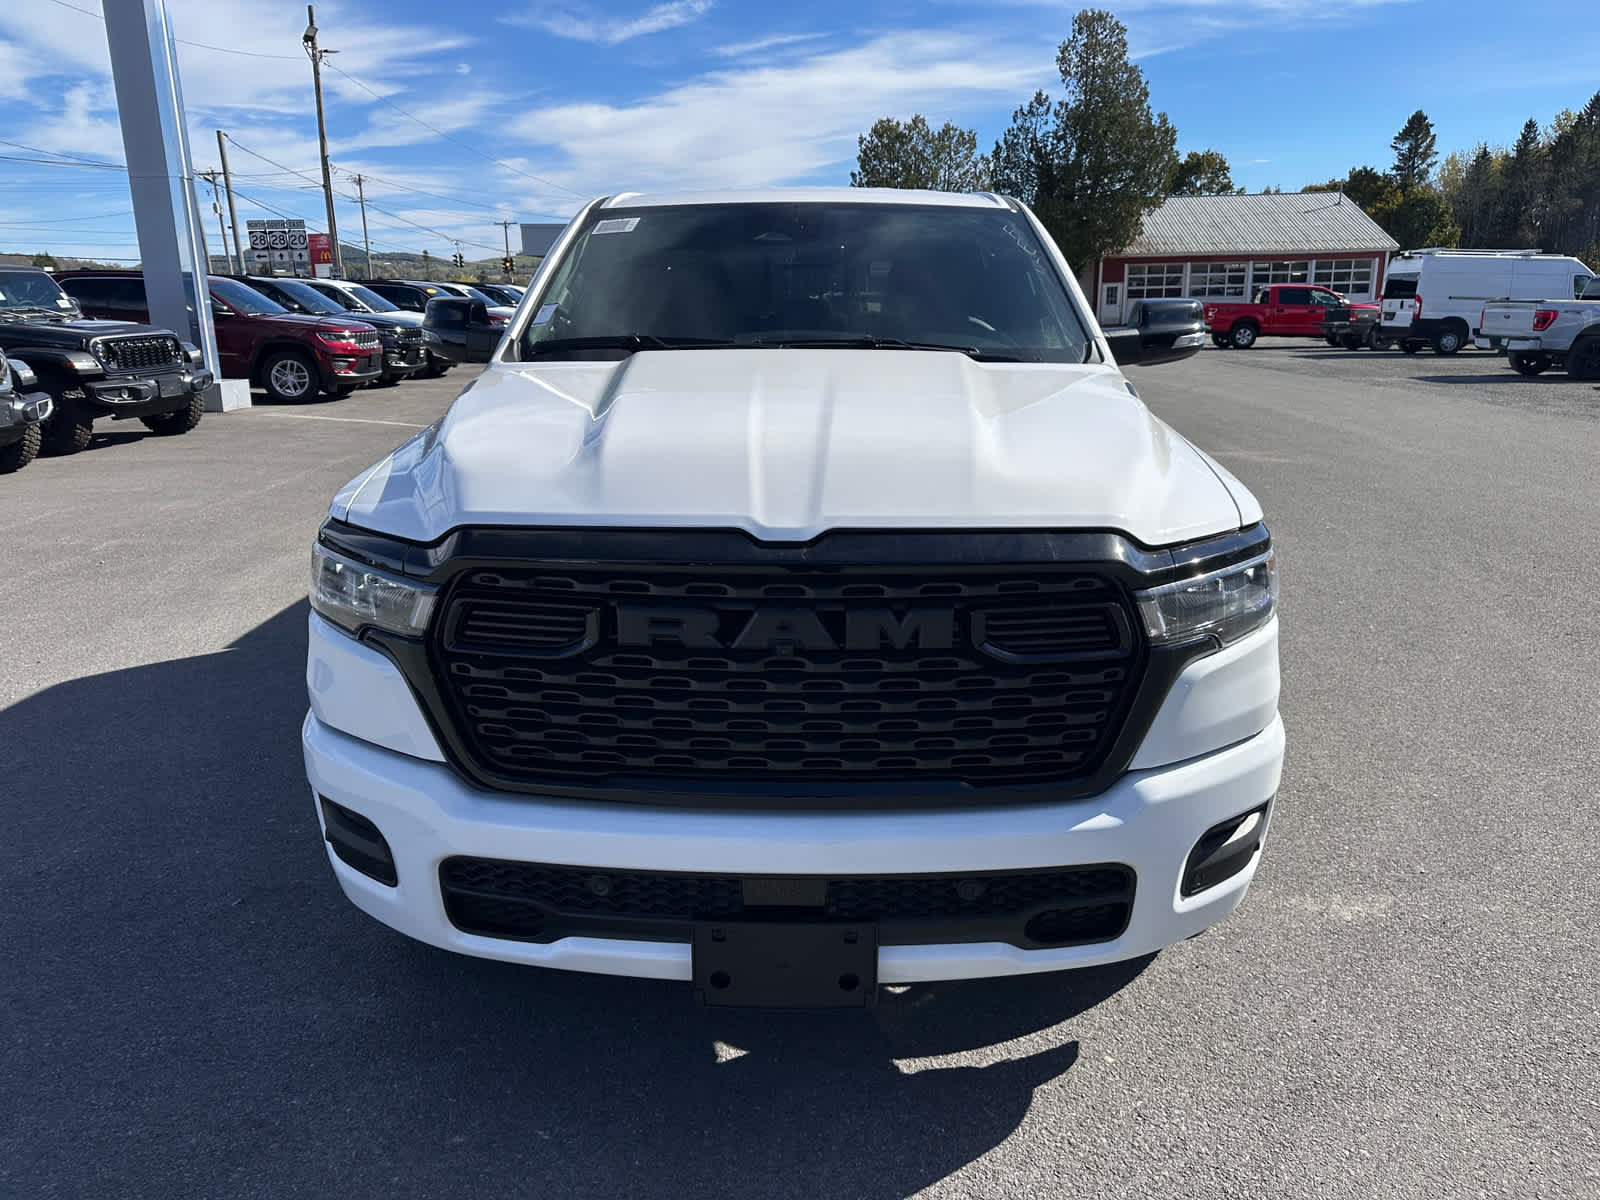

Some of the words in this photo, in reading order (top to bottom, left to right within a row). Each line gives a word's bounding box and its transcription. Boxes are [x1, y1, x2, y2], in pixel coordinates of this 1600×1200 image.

[251, 234, 267, 246] 28
[270, 234, 286, 246] 28
[290, 234, 306, 245] 20
[616, 606, 955, 649] RAM
